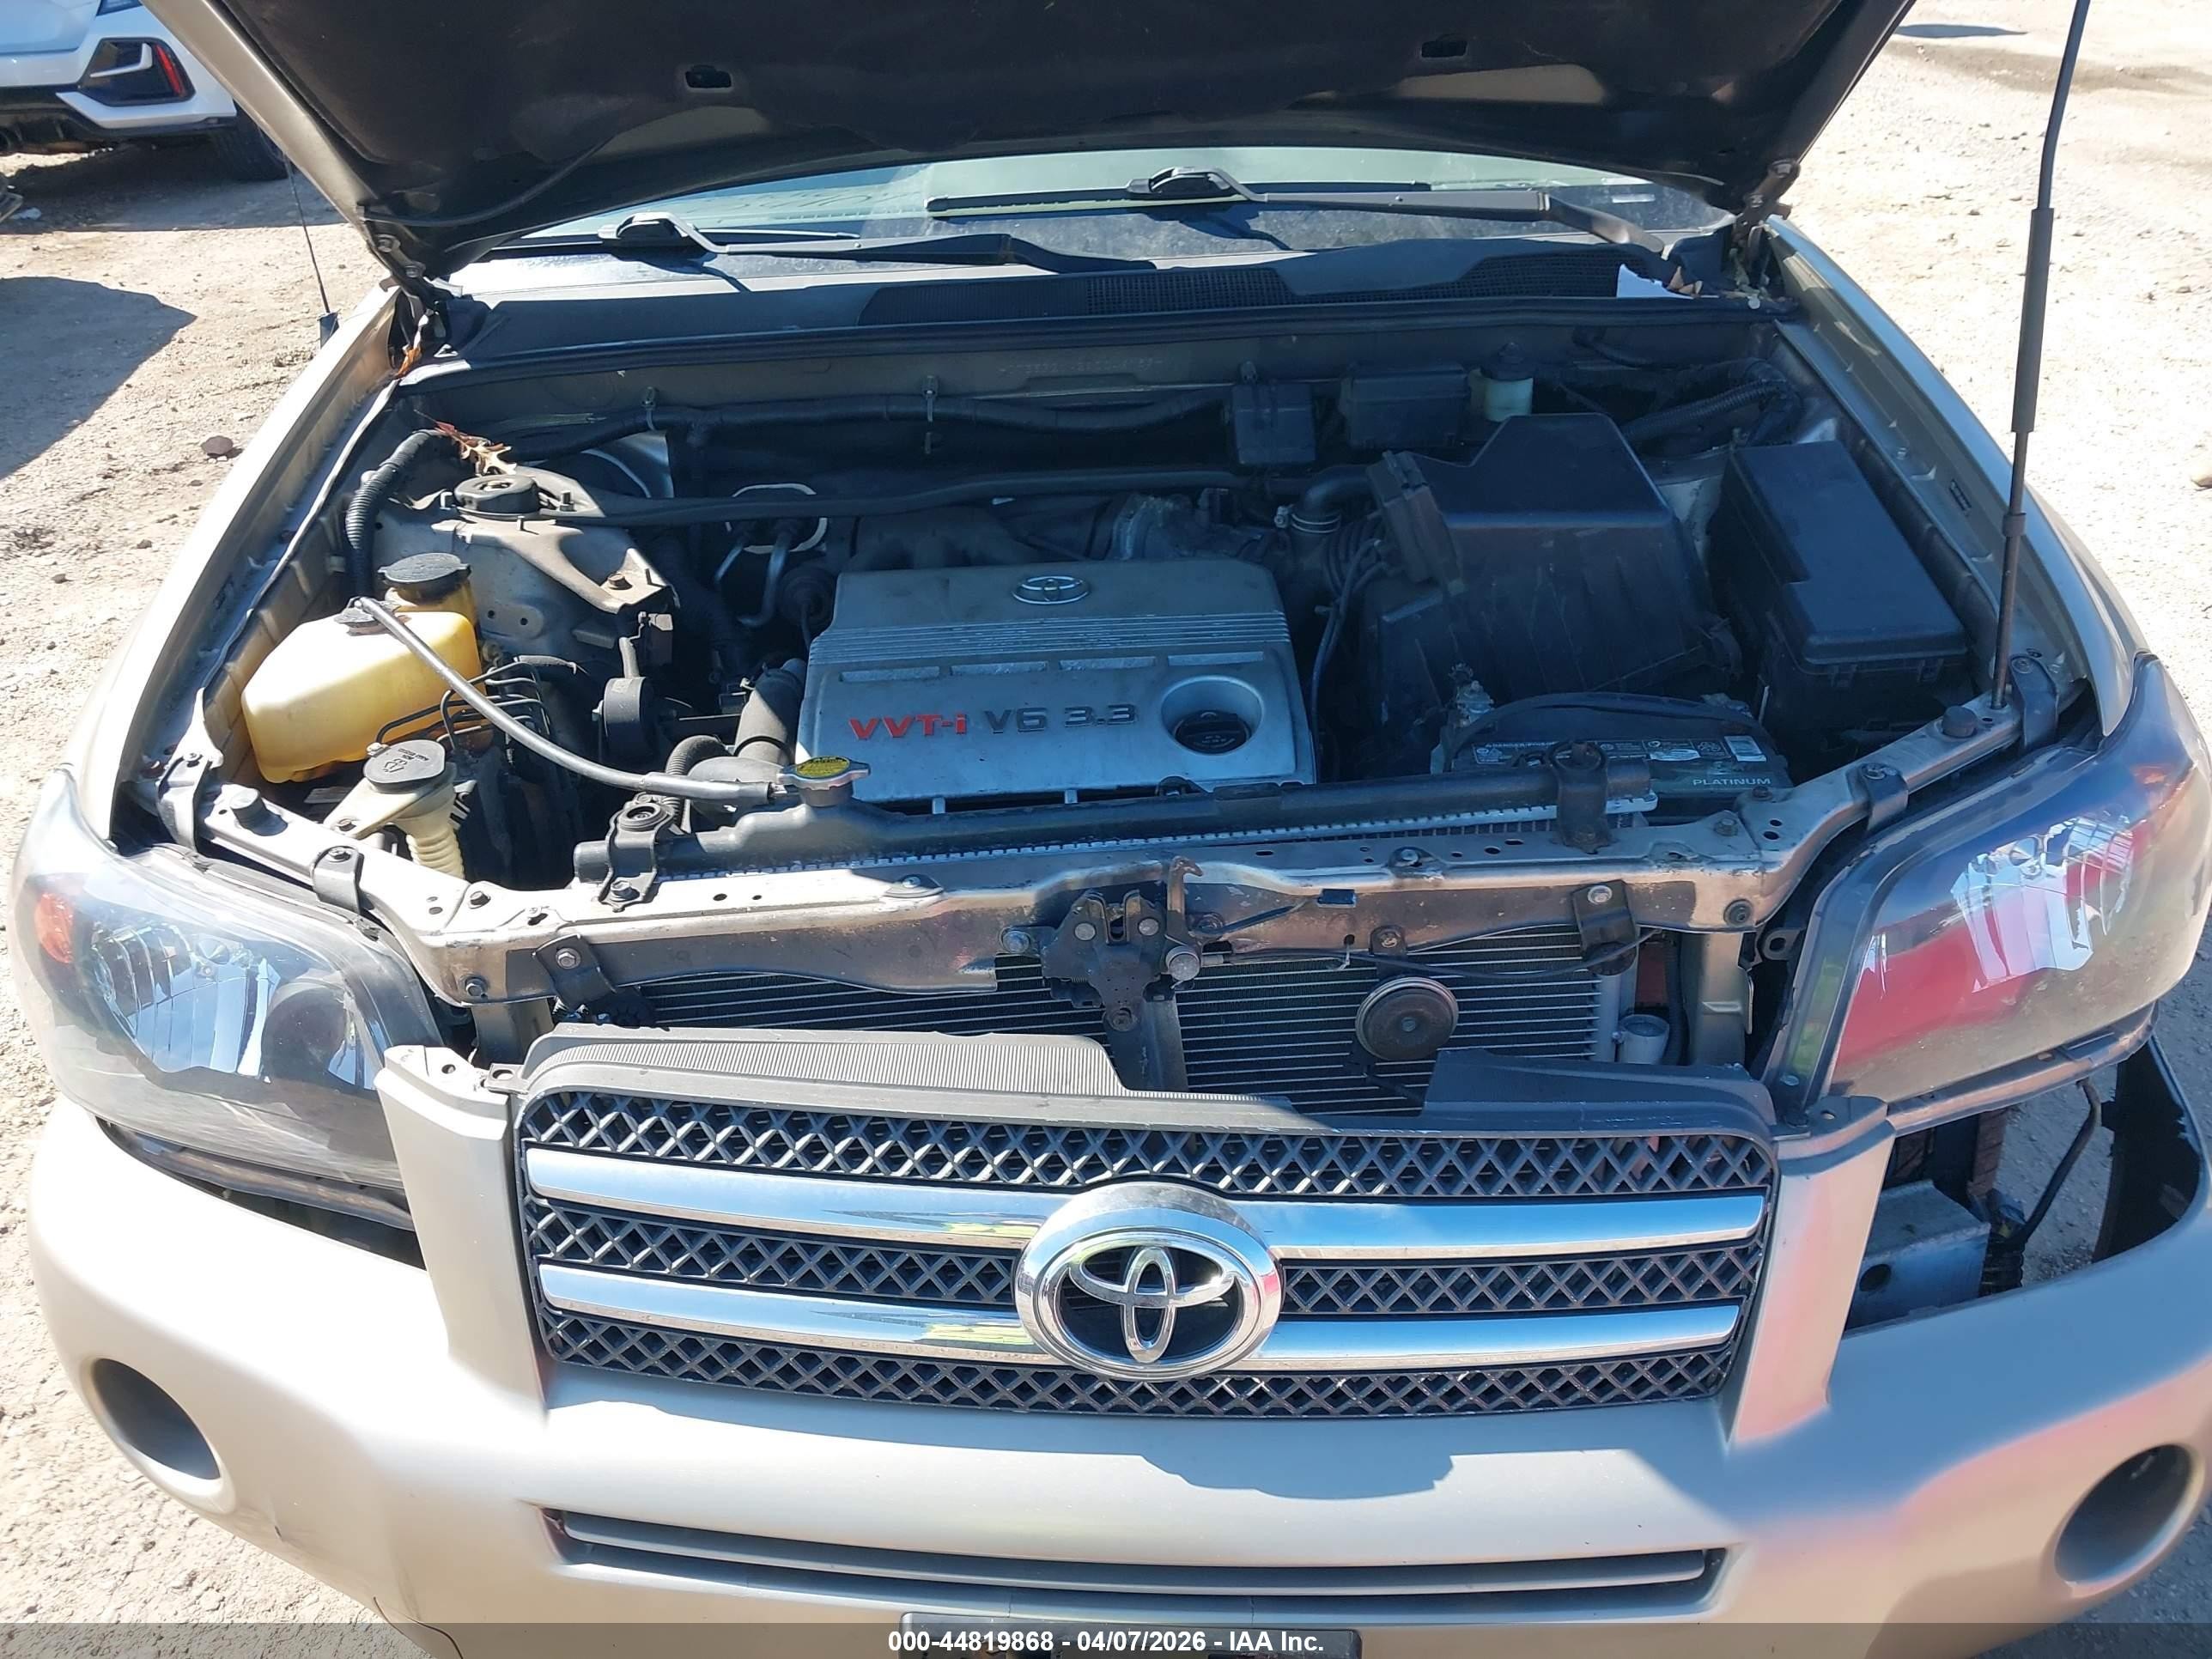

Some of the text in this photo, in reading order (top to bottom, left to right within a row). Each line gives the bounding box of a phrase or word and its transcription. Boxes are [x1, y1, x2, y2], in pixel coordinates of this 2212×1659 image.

[848, 703, 1136, 740] VVT-i V6 3.3
